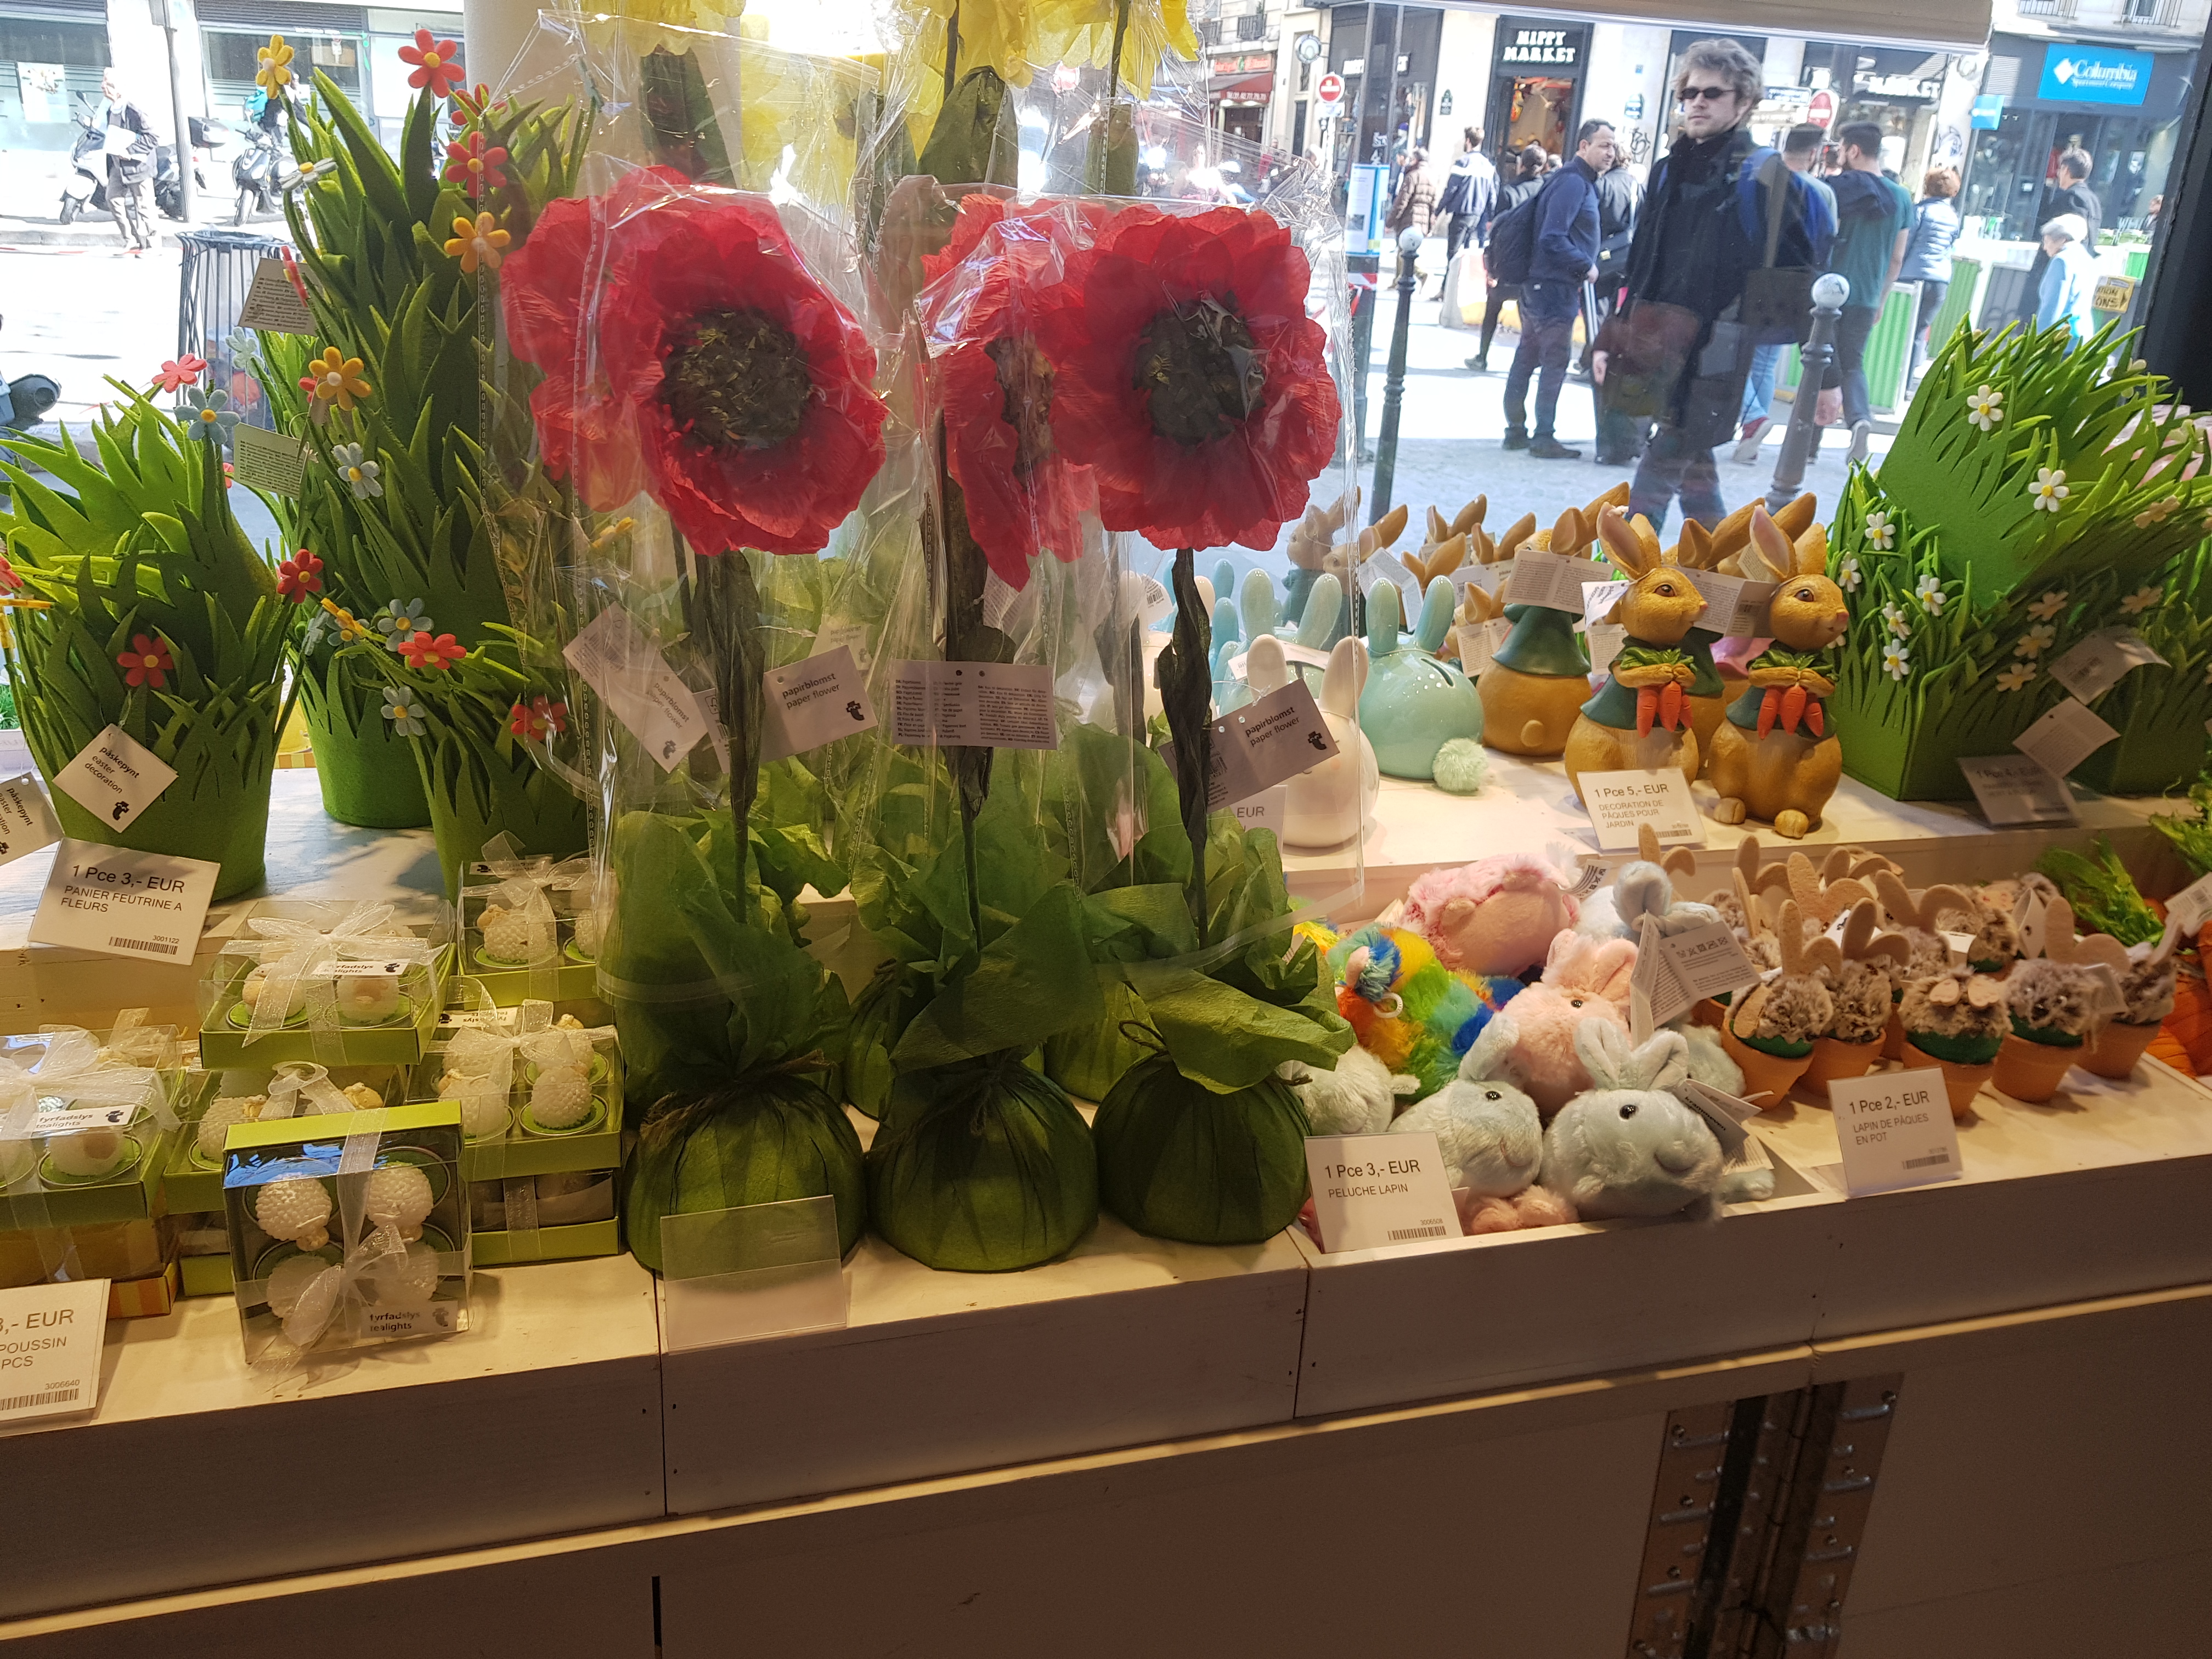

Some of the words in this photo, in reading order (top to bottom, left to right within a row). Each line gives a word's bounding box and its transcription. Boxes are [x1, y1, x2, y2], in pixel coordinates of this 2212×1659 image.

[1503, 47, 1576, 63] MARKET
[2074, 59, 2137, 82] Columbia
[782, 673, 836, 699] papirblomst
[653, 683, 690, 723] papirblomst
[787, 695, 810, 710] paper
[812, 684, 839, 698] flower
[645, 691, 664, 708] paper
[664, 708, 682, 729] flower
[1245, 707, 1295, 737] papirblomst
[1250, 731, 1273, 747] paper
[1274, 716, 1300, 734] flower
[92, 755, 115, 774] easter
[99, 742, 139, 778] påskepynt
[85, 763, 122, 794] decoration
[1594, 789, 1600, 798] 1
[1604, 788, 1624, 797] Pce
[1627, 786, 1641, 796] 5,-
[1644, 783, 1669, 794] EUR
[7, 788, 33, 826] påskepynt
[1237, 806, 1265, 817] EUR
[1599, 801, 1651, 811] DECORATION
[1637, 809, 1660, 817] POUR
[1606, 820, 1634, 828] JARDIN
[72, 865, 80, 877] 1
[85, 867, 116, 884] Pce
[121, 872, 142, 886] 3,-
[148, 877, 185, 893] EUR
[60, 898, 109, 913] FLEURS
[64, 885, 110, 900] PANIER
[112, 893, 171, 910] FEUTRINE
[174, 902, 183, 911] A
[153, 935, 179, 944] 3001122
[1849, 1101, 1856, 1115] 1
[1859, 1099, 1882, 1113] Pce
[1885, 1097, 1900, 1110] 2,-
[1903, 1091, 1930, 1106] EUR
[40, 1114, 93, 1123] fyrfadslys
[1853, 1121, 1878, 1133] LAPIN
[1880, 1119, 1892, 1128] DE
[1855, 1136, 1868, 1145] EN
[1870, 1132, 1887, 1143] POT
[1325, 1165, 1331, 1178] 1
[1336, 1164, 1363, 1178] Pce
[1366, 1163, 1385, 1177] 3,-
[1388, 1159, 1420, 1174] EUR
[1328, 1186, 1376, 1198] PELUCHE
[1378, 1183, 1408, 1194] LAPIN
[26, 1309, 74, 1329] EUR
[0, 1336, 67, 1354] POUSSIN
[1, 1356, 33, 1370] PCS
